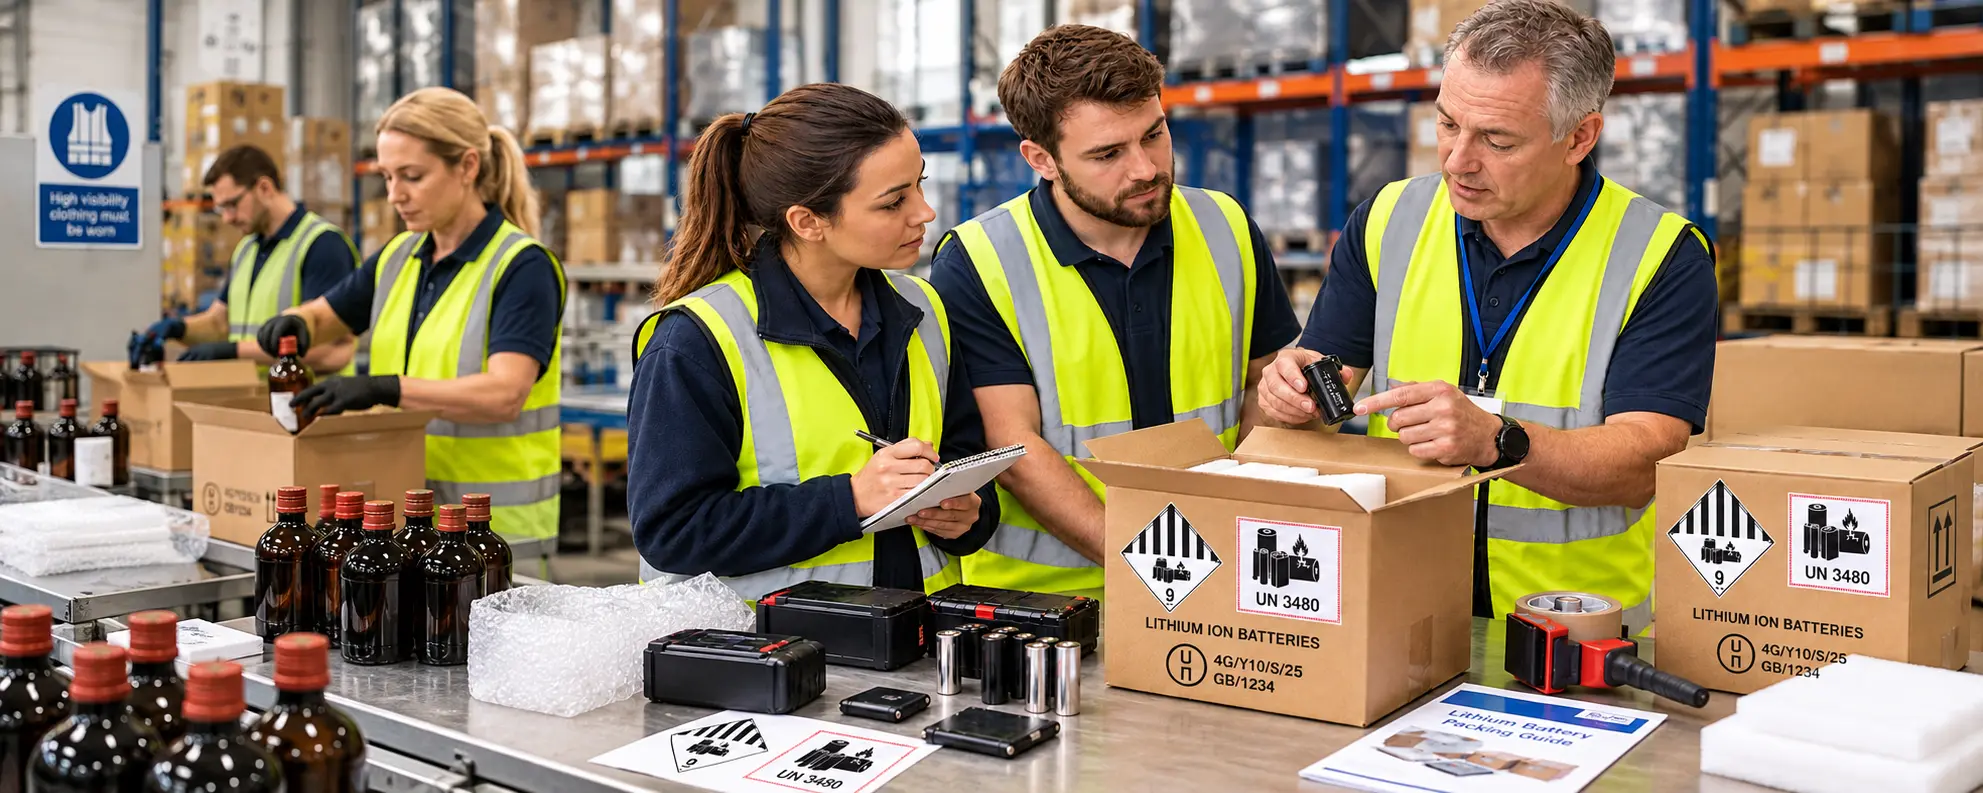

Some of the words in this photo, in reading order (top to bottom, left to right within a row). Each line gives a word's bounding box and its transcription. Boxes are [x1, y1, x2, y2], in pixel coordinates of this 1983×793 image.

[50, 191, 78, 208] High
[80, 192, 129, 210] visibility
[49, 207, 98, 225] clothing
[100, 210, 130, 224] must
[66, 222, 83, 237] be
[86, 225, 116, 237] worn
[1714, 570, 1724, 585] 9
[1805, 565, 1827, 581] UN
[1832, 569, 1871, 585] 3480
[1165, 588, 1175, 602] 9
[1256, 592, 1278, 606] UN
[1283, 595, 1320, 613] 3480
[1145, 616, 1203, 635] LITHIUM
[1207, 624, 1233, 639] ION
[1238, 628, 1320, 649] BATTERIES
[1693, 607, 1750, 626] LITHIUM
[1754, 614, 1779, 629] ION
[1783, 618, 1864, 639] BATTERIES
[1761, 643, 1847, 664] 4G/Y10/S/25
[1213, 654, 1303, 678] 4G/Y10/S/25
[1761, 660, 1820, 679] GB/1234
[1213, 672, 1275, 693] GB/1234
[1441, 718, 1513, 737] Packing
[1518, 732, 1574, 747] Guide
[1448, 709, 1516, 727] Lithium
[1522, 722, 1594, 740] Battery
[776, 769, 804, 782] UN
[803, 774, 843, 789] 3480
